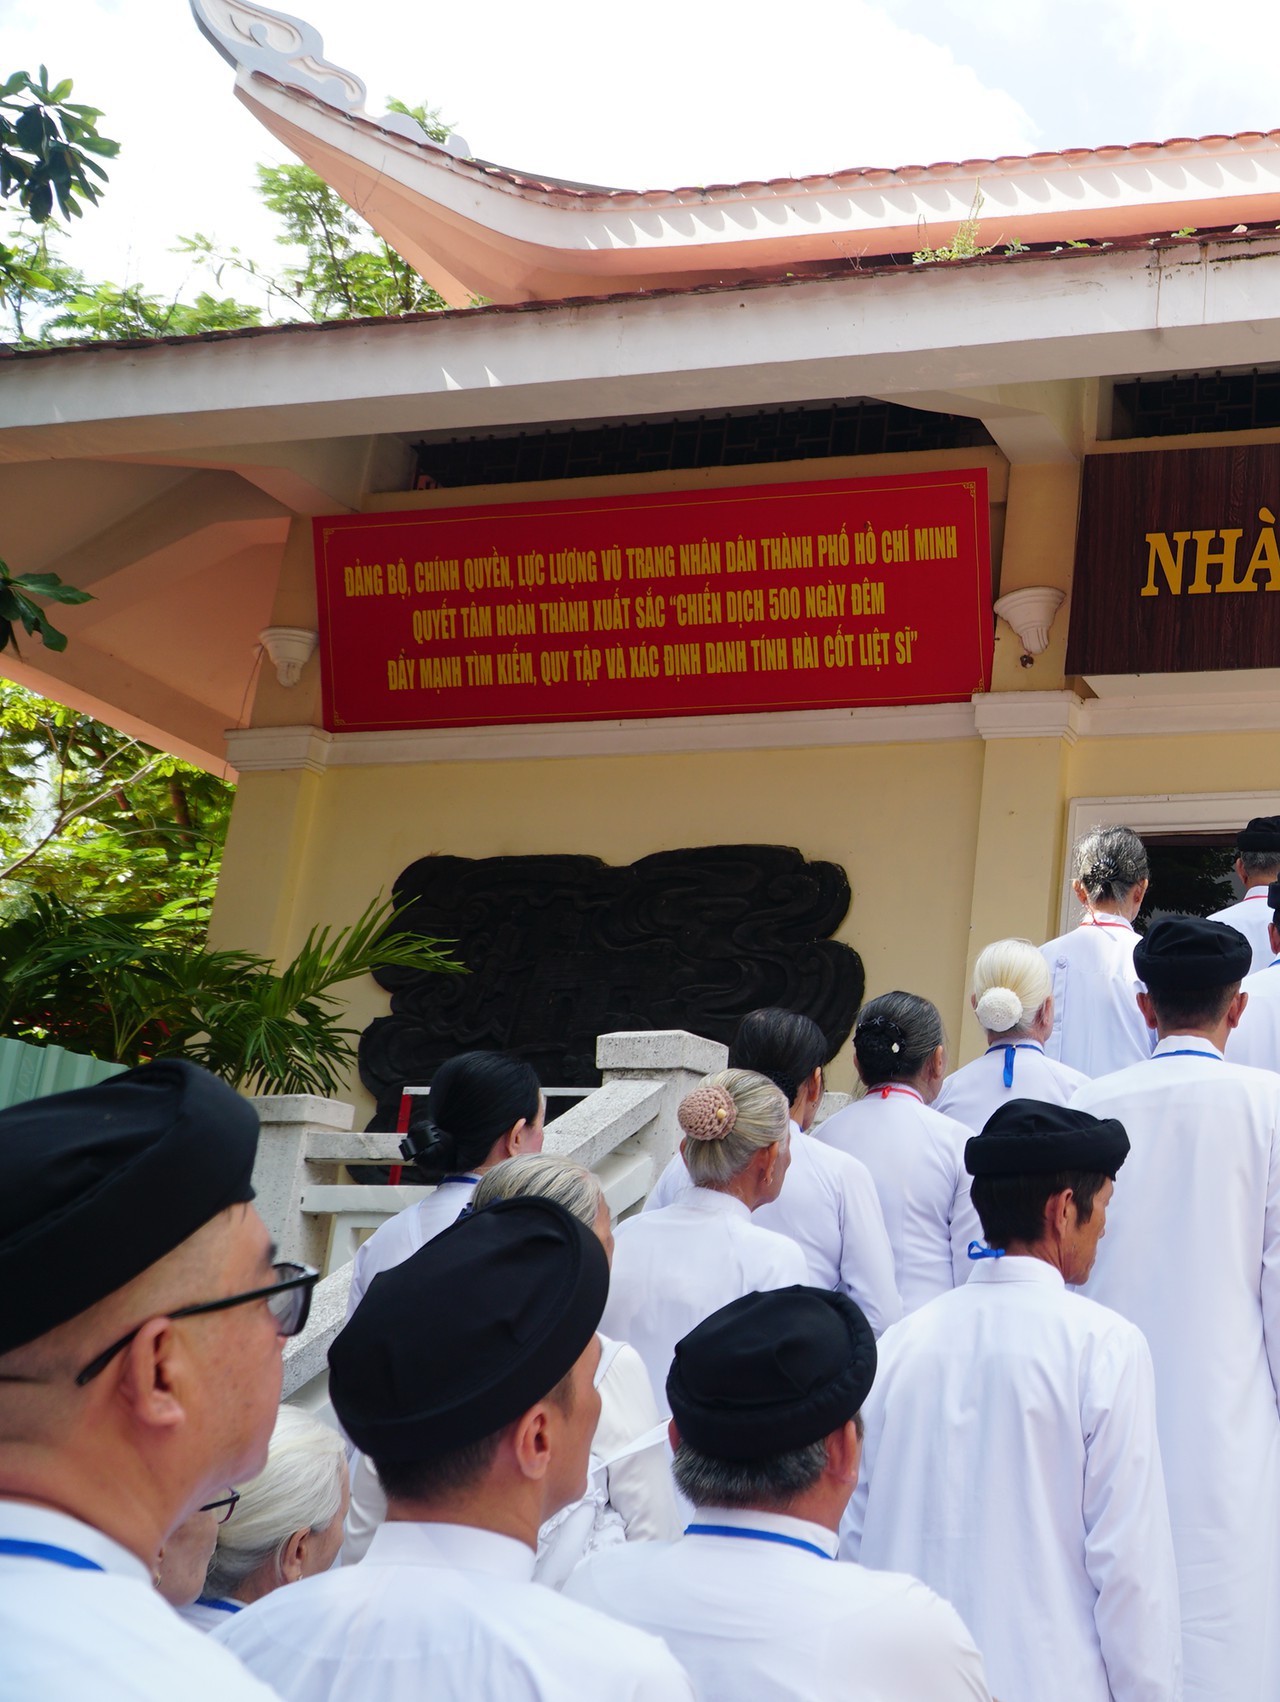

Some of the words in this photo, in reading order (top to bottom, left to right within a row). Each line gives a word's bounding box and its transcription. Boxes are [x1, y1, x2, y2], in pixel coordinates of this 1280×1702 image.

[344, 558, 384, 598] ĐẢNG
[387, 558, 411, 600] BỘ,
[414, 556, 461, 593] CHÍNH
[463, 546, 515, 593] QUYỀN,
[517, 550, 545, 592] LỰC
[549, 547, 597, 590] LƯỢNG
[601, 544, 622, 581] VŨ
[625, 545, 676, 580] TRANG
[679, 537, 722, 576] NHÂN
[725, 534, 757, 573] DÂN
[760, 532, 813, 571] THÀNH
[817, 522, 850, 568] PHỐ
[854, 520, 877, 566] HỒ
[881, 524, 910, 564] CHÍ
[914, 525, 958, 561] MINH
[412, 599, 457, 645] QUYẾT
[460, 601, 493, 639] TÂM
[496, 599, 536, 637] HOÀN
[539, 597, 589, 635] THÀNH
[593, 587, 631, 632] XUẤT
[635, 586, 666, 629] SẮC
[726, 588, 765, 630] DỊCH
[768, 586, 801, 621] 500
[805, 579, 847, 619] NGÀY
[850, 577, 885, 617] ĐÊM
[419, 655, 462, 695] MẠNH
[465, 650, 493, 687] TÌM
[496, 642, 537, 686] KIẾM,
[540, 650, 569, 687] QUY
[573, 644, 602, 688] TẬP
[605, 642, 627, 680] VÀ
[629, 641, 660, 679] XÁC
[663, 642, 702, 682] ĐỊNH
[705, 640, 748, 675] DANH
[750, 634, 788, 673] TÍNH
[823, 624, 855, 669] CỐT
[858, 627, 890, 673] LIỆT
